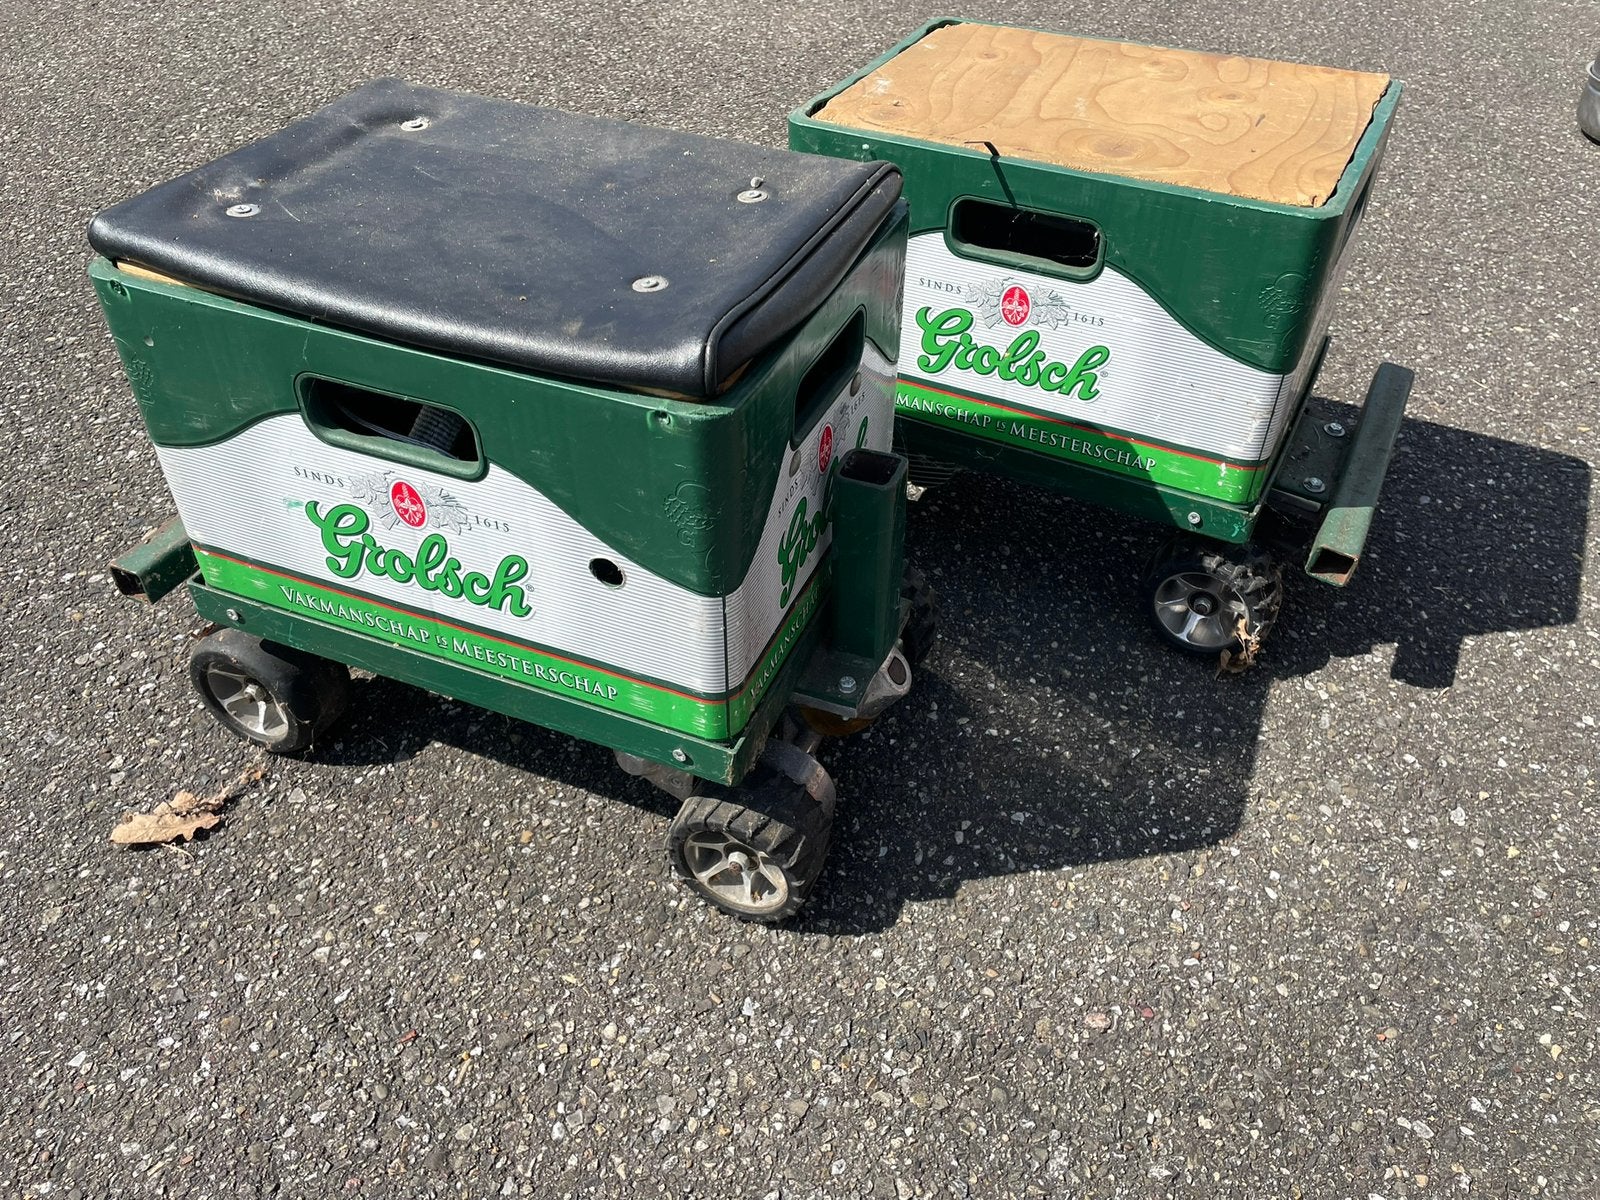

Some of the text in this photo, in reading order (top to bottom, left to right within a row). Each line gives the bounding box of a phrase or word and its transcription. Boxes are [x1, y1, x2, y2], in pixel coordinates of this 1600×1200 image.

[919, 277, 1106, 327] SINDS 1615
[915, 306, 1111, 401] Grolsch
[896, 393, 992, 429] MANSCHAP
[1009, 422, 1156, 472] MEESTERSCHAP
[293, 466, 511, 533] SINDS 1615
[305, 500, 533, 618] Grolsch
[278, 584, 431, 644] VAKMANSCHAP
[452, 637, 619, 701] MEESTERSCHAP
